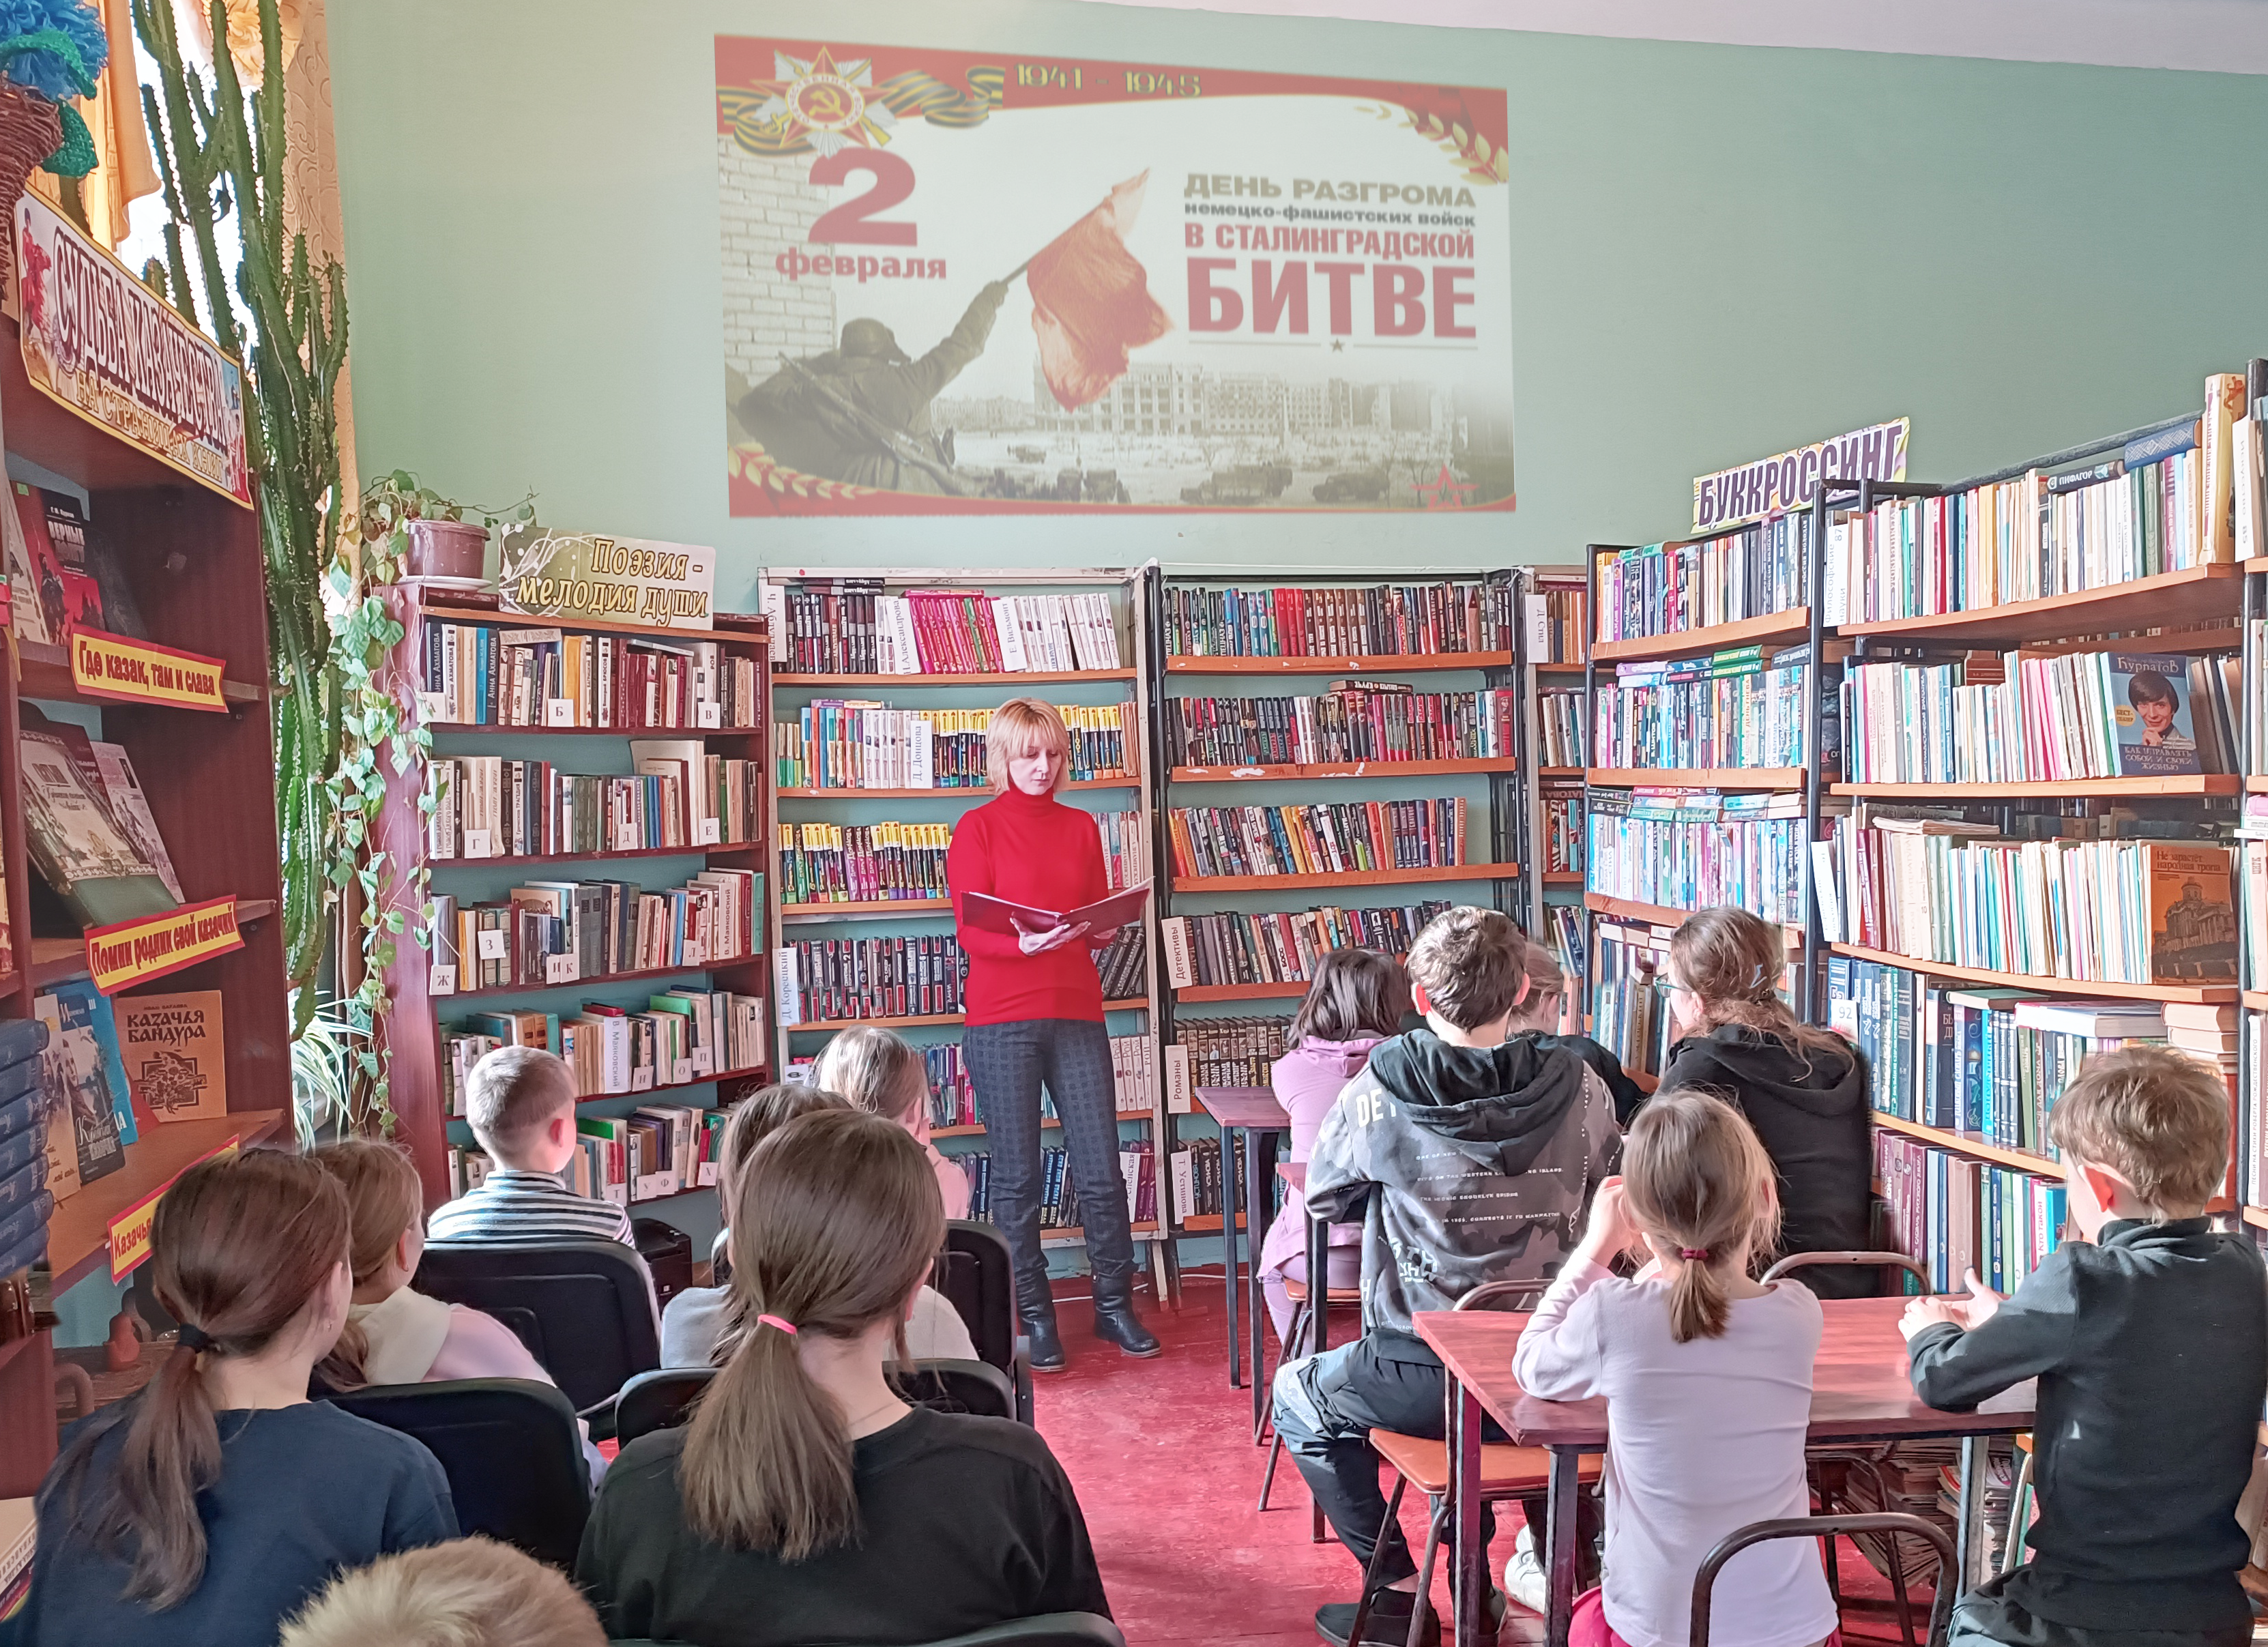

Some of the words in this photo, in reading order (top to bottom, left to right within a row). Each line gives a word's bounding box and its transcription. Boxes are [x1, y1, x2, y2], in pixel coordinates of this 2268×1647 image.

[1015, 63, 1083, 90] 1941
[1123, 70, 1202, 98] 1945
[808, 147, 918, 247] 2
[1184, 173, 1282, 199] ДЕНЬ
[1293, 177, 1476, 207] РАЗГРОМА
[1184, 203, 1412, 224] немецко-фашистских
[1418, 210, 1476, 227] войск
[1184, 222, 1204, 249] В
[1215, 222, 1474, 261] СТАЛИНГРАДСКОЙ
[775, 247, 947, 283] февраля
[1187, 257, 1477, 338] БИТВЕ
[53, 225, 130, 385] СУДЬБА
[128, 287, 227, 450] КАЗАЧЕСТВА
[76, 368, 99, 414] НА
[102, 385, 187, 467] СТРАНИЦАХ
[191, 439, 223, 483] КНИГ
[1698, 423, 1904, 529] БУККРОССИНГ
[2059, 470, 2093, 486] ПИФАГОР
[1834, 528, 1843, 542] 87
[591, 538, 690, 581] Поэзия
[1824, 544, 1835, 623] Философские
[515, 576, 638, 615] мелодия
[640, 586, 708, 627] души
[767, 594, 777, 603] Ч.
[1838, 587, 1847, 622] науки
[1002, 602, 1016, 643] Вильмонт
[1537, 609, 1545, 619] Д.
[1219, 628, 1227, 656] ПЕЦНАЗ
[1537, 621, 1546, 643] Стил
[433, 632, 441, 673] АХМАТОВА
[488, 637, 497, 675] АХМАТОВА
[79, 640, 103, 682] Где
[106, 654, 149, 692] казак,
[151, 663, 173, 688] там
[175, 673, 184, 691] и
[185, 673, 216, 697] слава
[488, 677, 496, 699] АННА
[555, 706, 564, 716] Б
[705, 710, 712, 720] В
[912, 725, 923, 768] Донцова
[912, 770, 923, 781] Д.
[622, 831, 630, 844] Д
[705, 826, 712, 836] Е
[472, 839, 480, 850] Г
[2157, 850, 2168, 860] Не
[2157, 861, 2194, 872] народная
[2197, 863, 2221, 873] тропа
[2251, 857, 2262, 875] ЦИРК
[91, 942, 134, 977] Помни
[135, 931, 173, 970] родник
[174, 914, 198, 951] свой
[198, 903, 236, 944] казачий
[485, 939, 493, 950] З
[724, 946, 730, 955] В.
[688, 947, 696, 958] Л
[1170, 927, 1186, 980] Детективы
[1279, 947, 1288, 967] БОСС
[566, 962, 573, 974] К
[437, 975, 450, 987] Ж
[781, 1008, 792, 1019] Д.
[1837, 1006, 1853, 1020] 92
[128, 1025, 206, 1047] БАНДУРА
[612, 1032, 620, 1088] Маяковский
[699, 1052, 707, 1062] П
[678, 1066, 686, 1075] О
[1174, 1060, 1182, 1101] Романы
[1178, 1158, 1186, 1169] Т.
[2252, 1154, 2257, 1163] НА
[660, 1178, 669, 1187] Ф
[1126, 1154, 1135, 1201] спенская
[613, 1189, 620, 1199] Т
[1178, 1171, 1187, 1214] Устинова
[1459, 1193, 1494, 1201] BROOKLYN
[114, 1217, 152, 1260] Казачья
